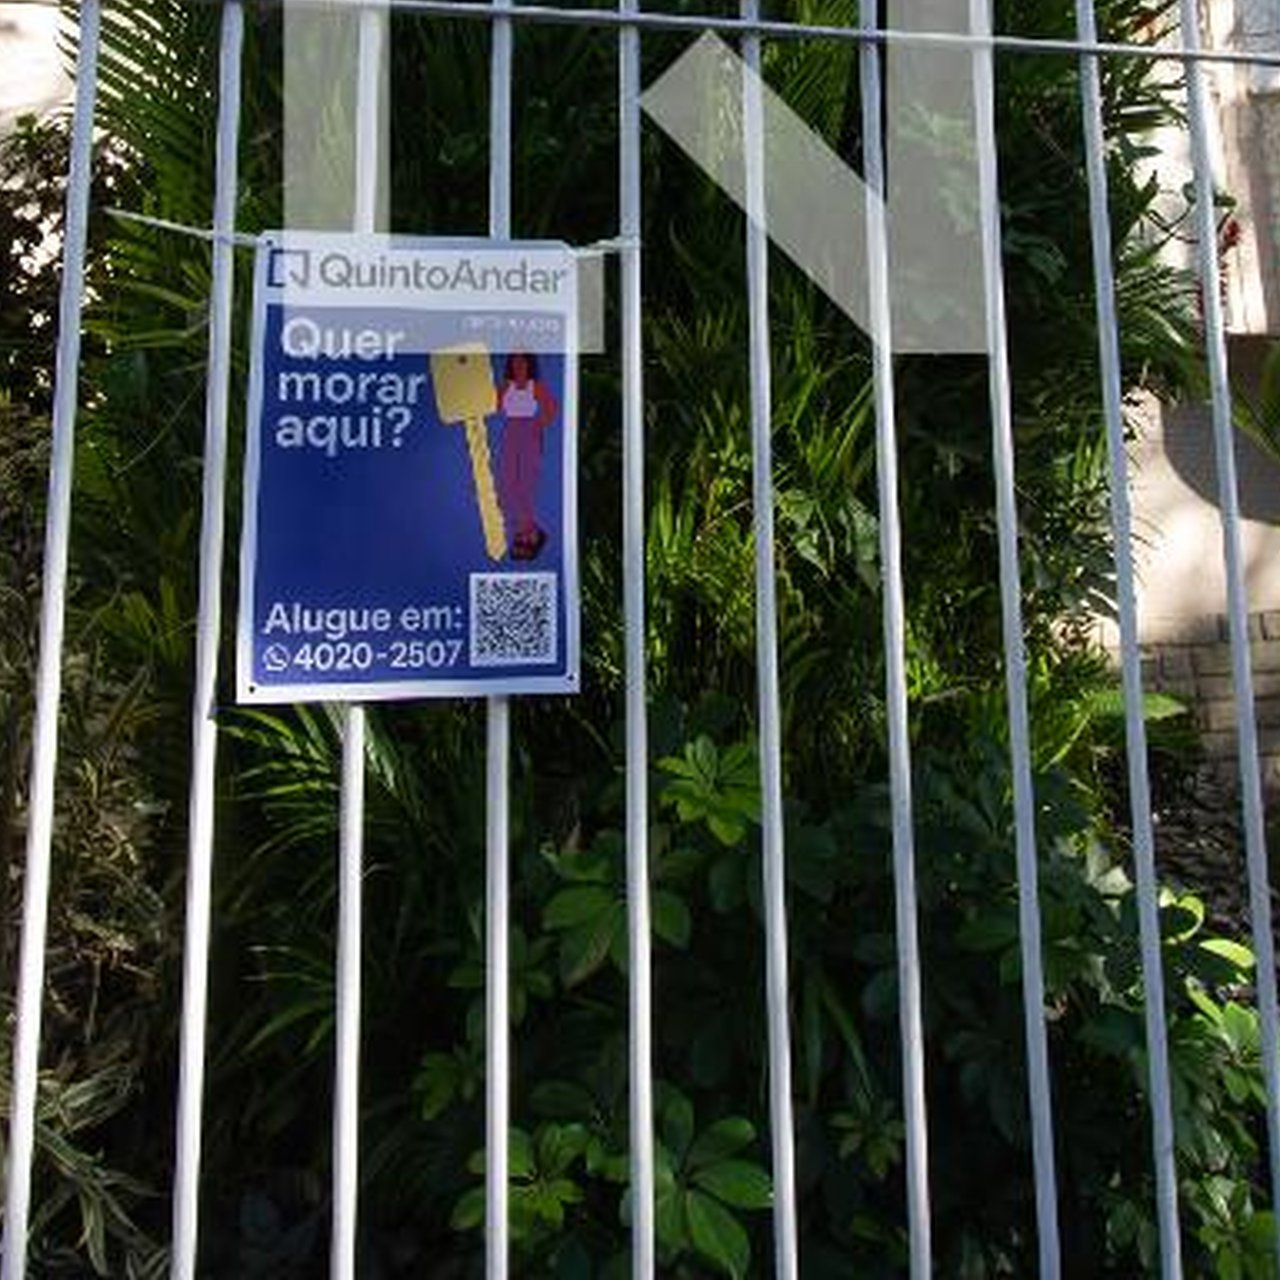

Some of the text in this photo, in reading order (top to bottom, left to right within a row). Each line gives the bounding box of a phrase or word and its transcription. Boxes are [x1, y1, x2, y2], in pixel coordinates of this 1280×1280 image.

[319, 252, 567, 294] QuintoAndar
[281, 316, 405, 362] Quer
[278, 371, 426, 405] morar
[275, 407, 412, 457] aqui?
[263, 602, 463, 639] Alugue em:
[293, 640, 464, 670] 4020-2507
